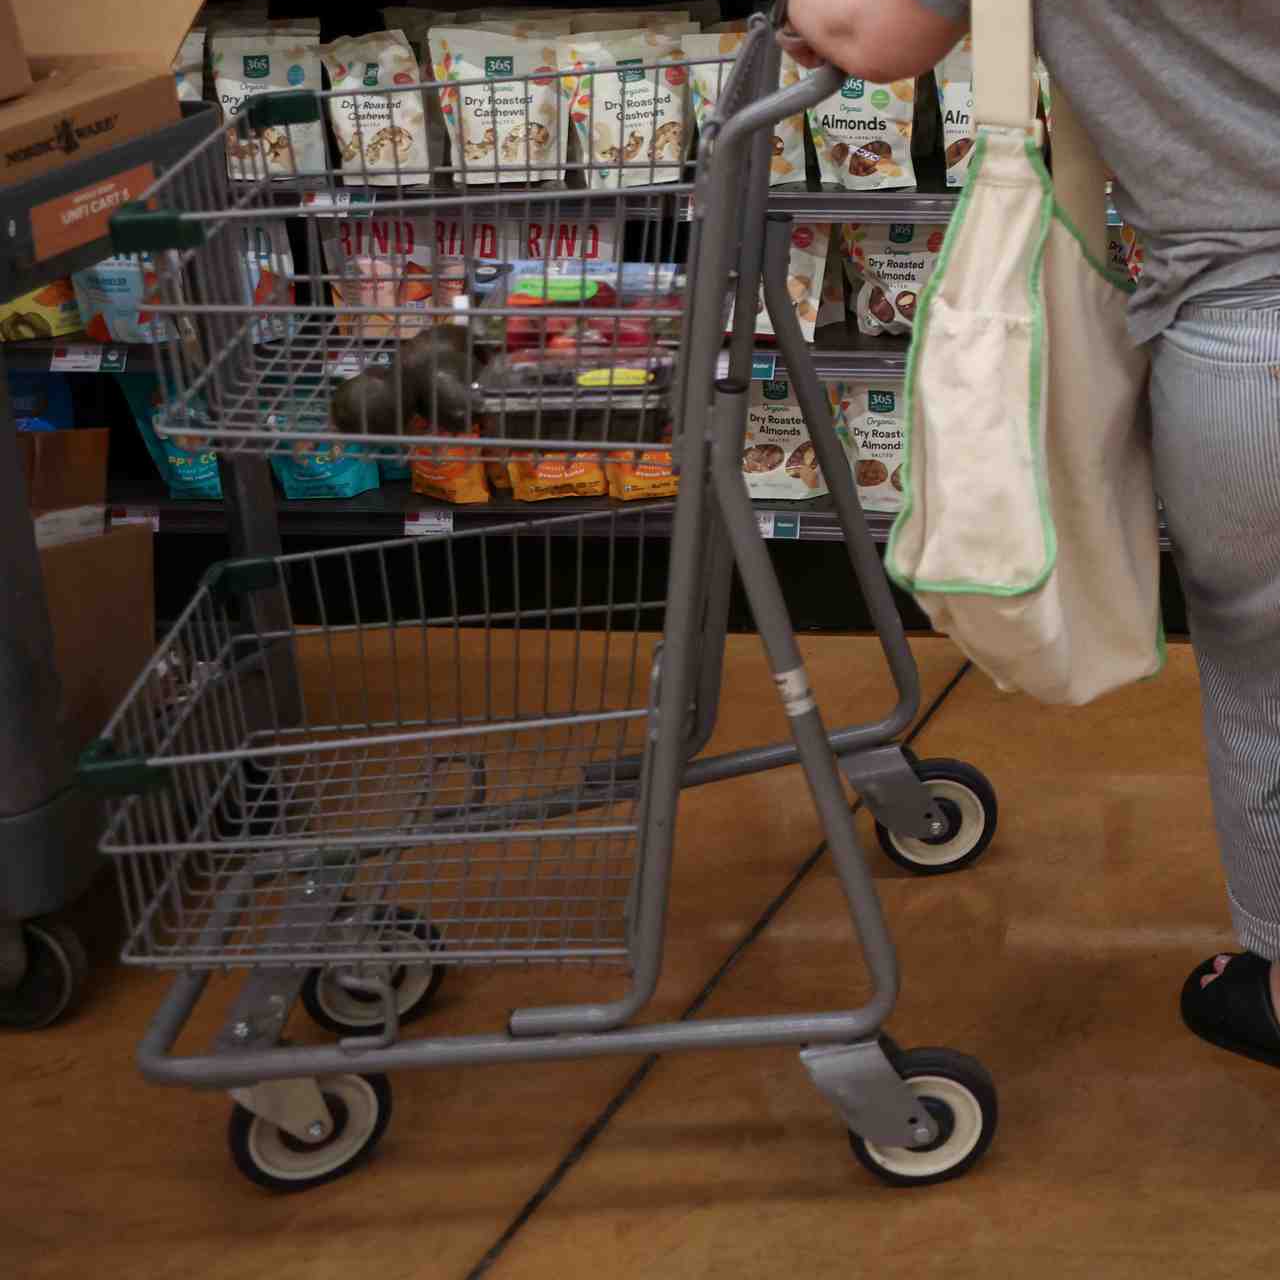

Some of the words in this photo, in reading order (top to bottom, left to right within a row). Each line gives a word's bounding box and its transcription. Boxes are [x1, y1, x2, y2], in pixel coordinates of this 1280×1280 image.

[822, 115, 886, 130] Almonds
[869, 258, 884, 270] Dry
[886, 260, 925, 270] Roasted
[874, 271, 916, 282] Almonds
